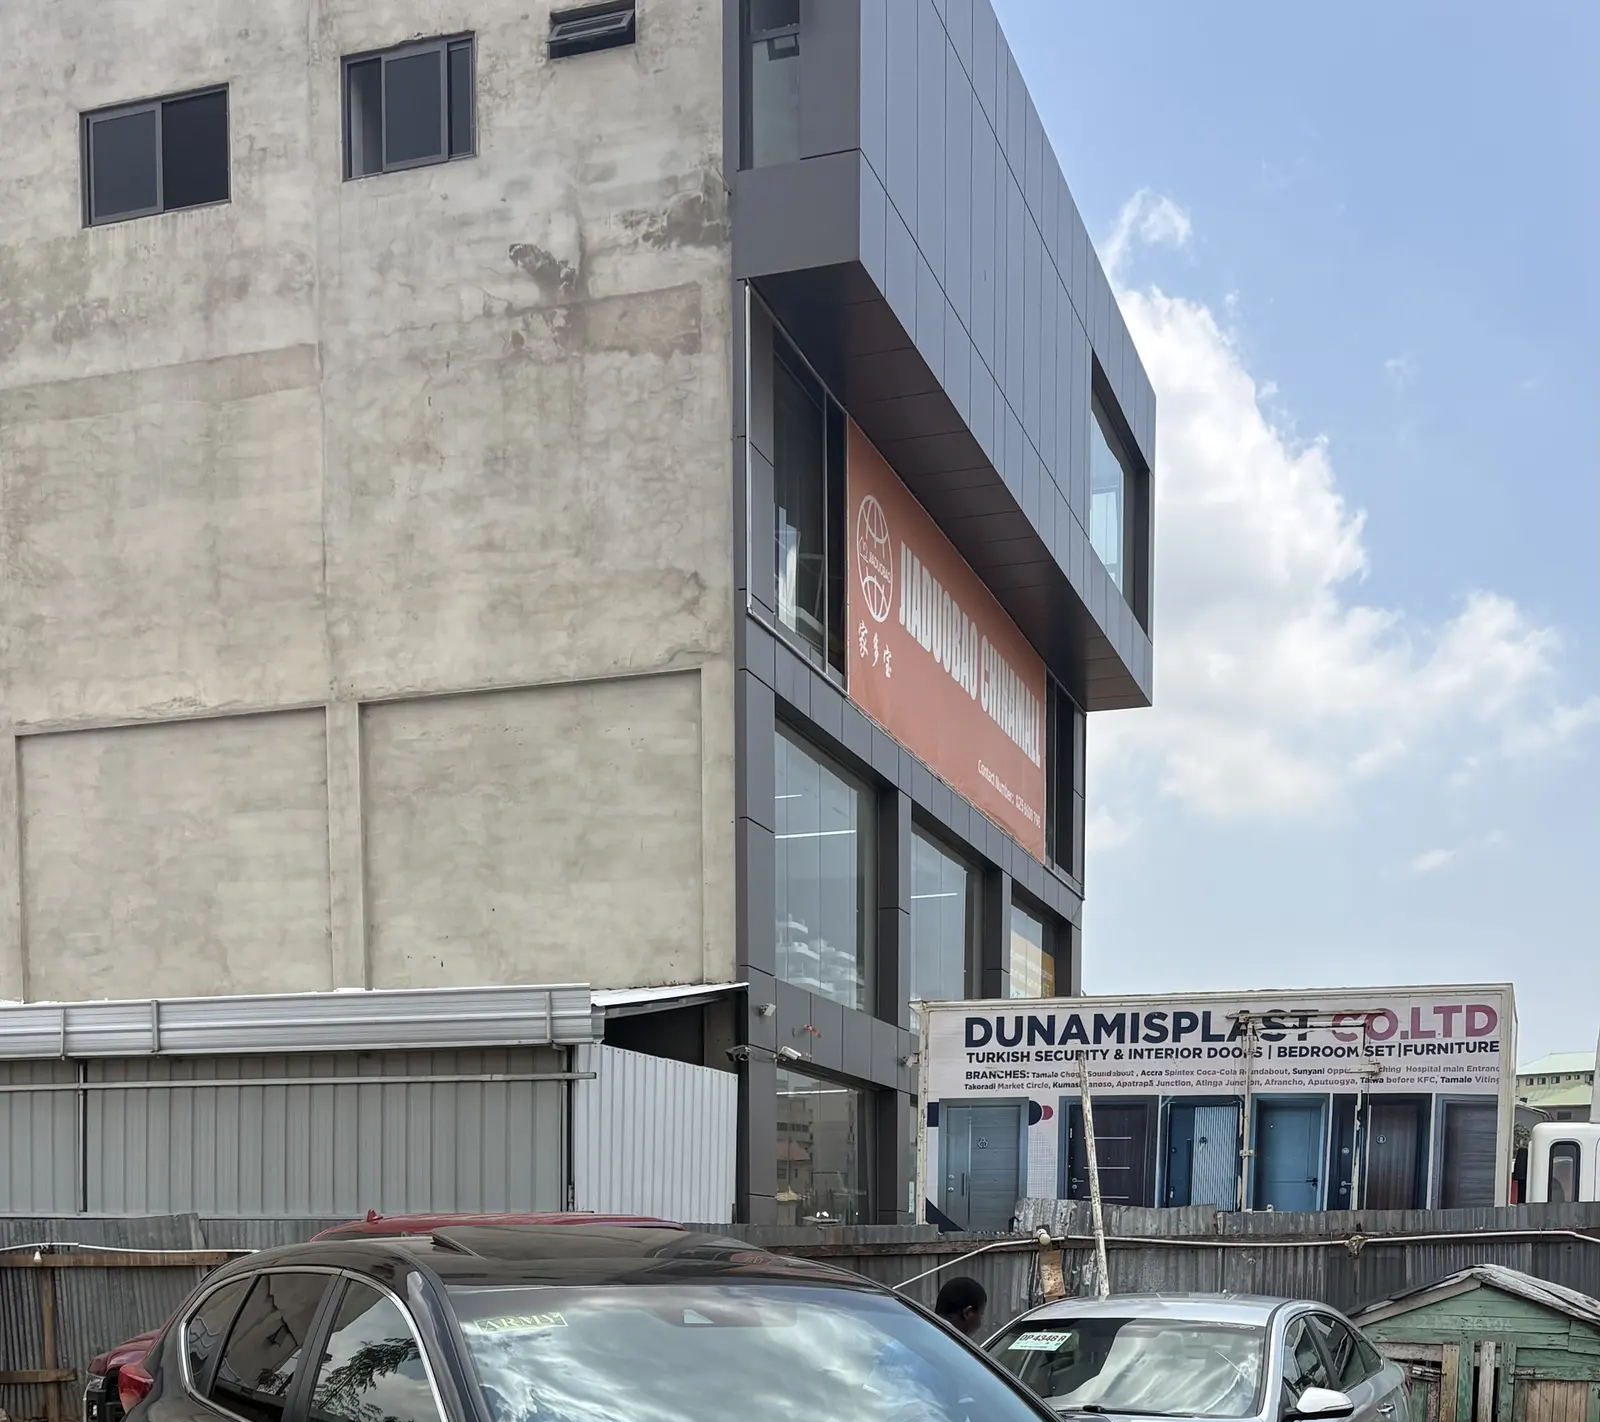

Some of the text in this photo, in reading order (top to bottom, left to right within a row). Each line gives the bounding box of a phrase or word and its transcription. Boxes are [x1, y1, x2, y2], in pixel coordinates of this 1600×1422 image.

[899, 540, 978, 700] JIADUOBAO
[964, 1009, 1319, 1048] DUNAMISPLAST
[966, 1051, 1030, 1064] TURKISH
[1113, 1048, 1124, 1060] &
[1128, 1047, 1202, 1060] INTERIOR
[1277, 1045, 1359, 1058] BEDROOM
[965, 1069, 1030, 1080] BRANCHES:
[1031, 1071, 1059, 1079] Tamale
[1140, 1069, 1163, 1077] Accra
[1164, 1068, 1194, 1077] Spintex
[1196, 1068, 1237, 1076] Coca-Cola
[1239, 1067, 1291, 1076] Rundabout,
[1292, 1067, 1325, 1076] Sunyani
[1405, 1065, 1441, 1074] Hospital
[1442, 1065, 1465, 1073] main
[964, 1083, 996, 1091] Takoradi
[997, 1082, 1024, 1090] Market
[1026, 1082, 1051, 1090] Circle,
[1155, 1079, 1194, 1088] Junction,
[1195, 1079, 1223, 1087] Atinga
[1225, 1079, 1263, 1087] Juncton,
[1264, 1078, 1306, 1087] Afrancho,
[1386, 1075, 1415, 1084] before
[1417, 1075, 1438, 1085] KFC,
[1440, 1075, 1473, 1084] Tamale
